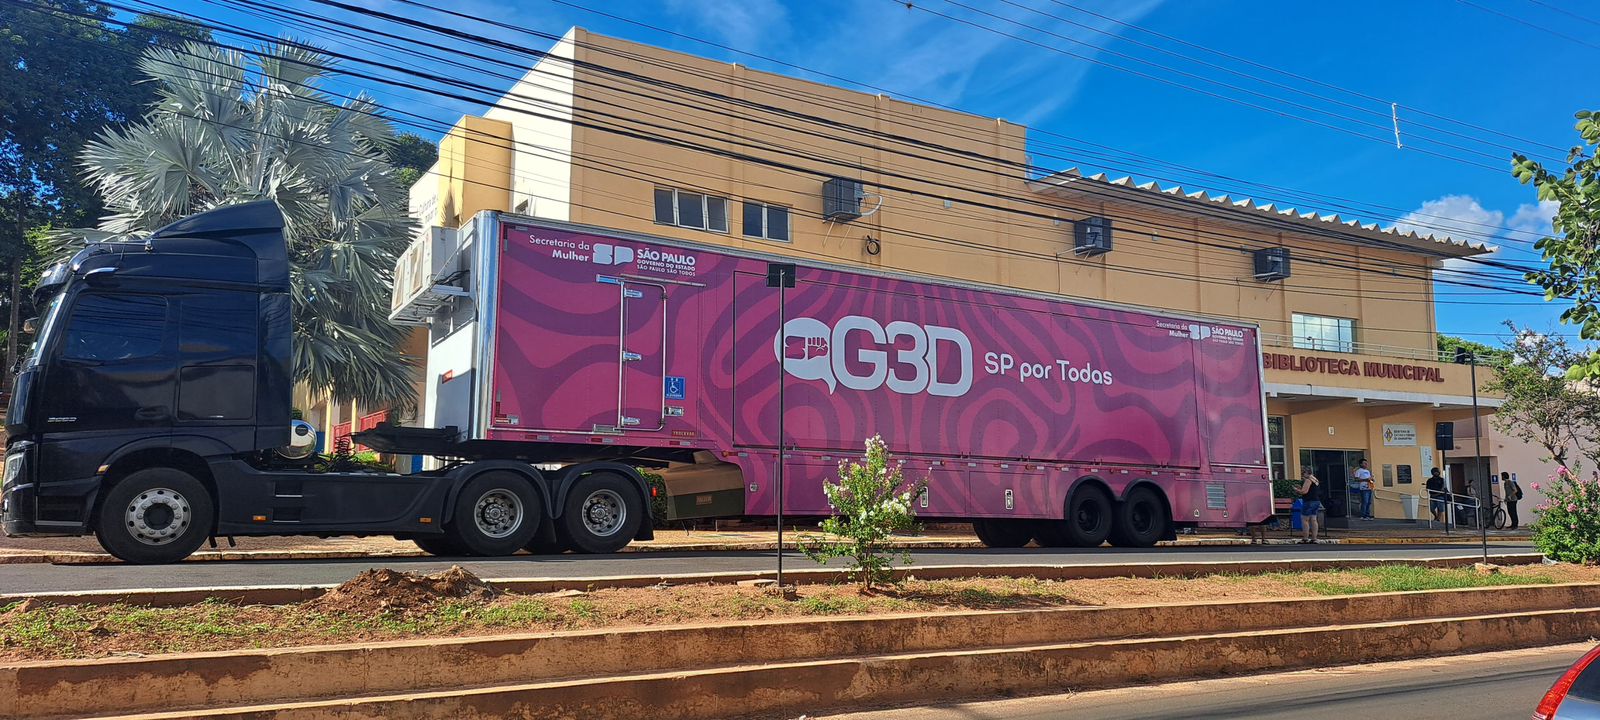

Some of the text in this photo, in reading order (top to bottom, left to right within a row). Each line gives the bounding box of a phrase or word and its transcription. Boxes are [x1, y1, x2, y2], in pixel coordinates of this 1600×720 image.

[529, 234, 590, 250] Secretaria da
[552, 249, 590, 262] Mulher
[637, 247, 696, 266] SÃO PAULO
[636, 259, 665, 267] GOVERNO
[675, 264, 696, 272] ESTADO
[1225, 328, 1243, 338] PAULO
[984, 352, 1113, 385] SP por Todas
[1262, 352, 1444, 382] BIBLIOTECA MUNICIPAL
